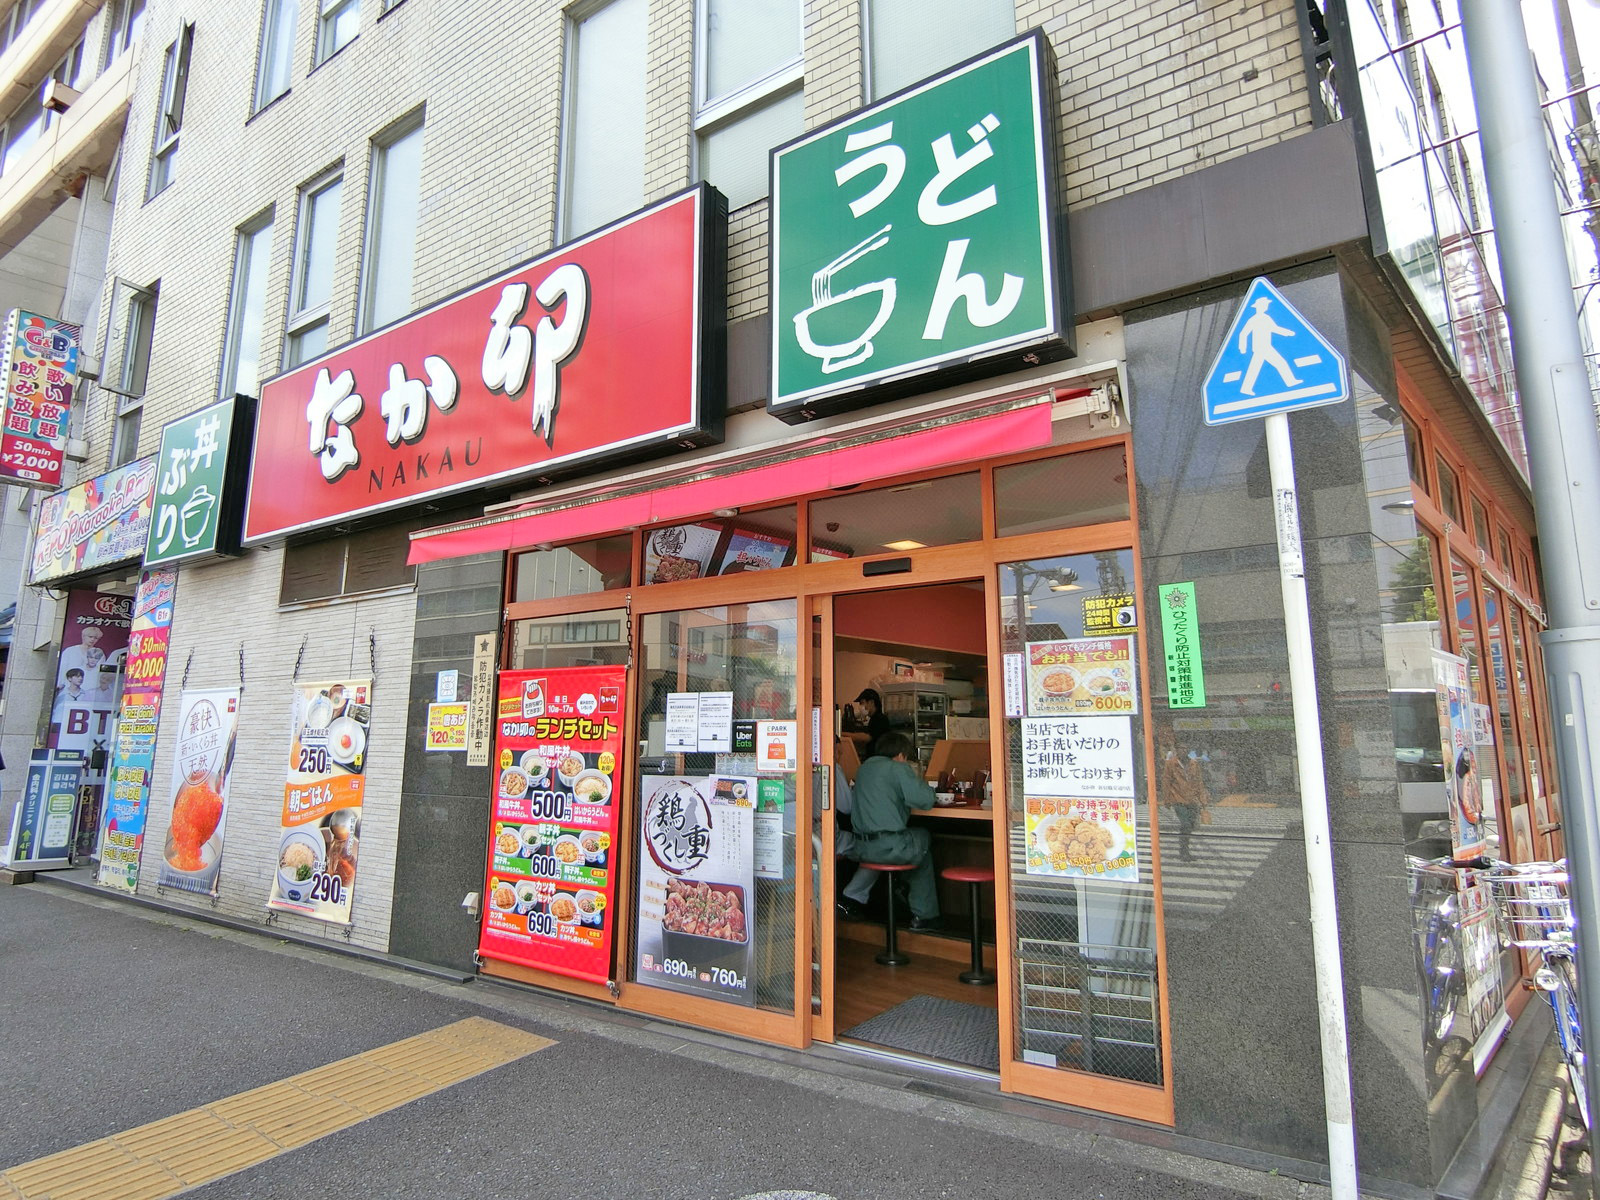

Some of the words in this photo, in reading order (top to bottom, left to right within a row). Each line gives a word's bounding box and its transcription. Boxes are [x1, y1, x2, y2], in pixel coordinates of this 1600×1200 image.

[834, 112, 1025, 340] うどん
[26, 328, 70, 352] G&B
[306, 263, 590, 480] なか卯
[10, 360, 38, 433] 飲み放題
[38, 367, 65, 440] 歌い放題
[13, 440, 52, 456] 50min
[2, 452, 60, 472] ¥2,000
[368, 437, 484, 494] NAKAU
[157, 413, 222, 554] 丼ぶり
[1085, 596, 1134, 610] 防犯カメラ
[1086, 609, 1110, 618] 24時間
[1086, 617, 1111, 626] 監視中
[141, 637, 166, 654] 50min
[1054, 641, 1112, 652] いつでもランチ価格
[1041, 650, 1128, 664] お弁当でも!!
[1172, 610, 1195, 705] ひったくり防止対策推進地区
[127, 656, 164, 680] ¥2,000
[474, 660, 488, 752] 防犯カメラ作動中
[1095, 697, 1132, 709] 600円
[67, 708, 114, 735] BT
[1026, 723, 1079, 736] 当店では
[736, 731, 752, 740] Uber
[1025, 737, 1120, 750] お手洗いだけの
[736, 740, 752, 748] Eats
[1026, 752, 1077, 765] ご利用を
[1026, 766, 1126, 780] お断りしております
[288, 783, 334, 813] 朝ごはん
[1076, 799, 1130, 811] お持ち帰り
[1027, 798, 1071, 816] 唐あげ
[19, 842, 31, 850] 4F
[1106, 857, 1136, 870] 300円
